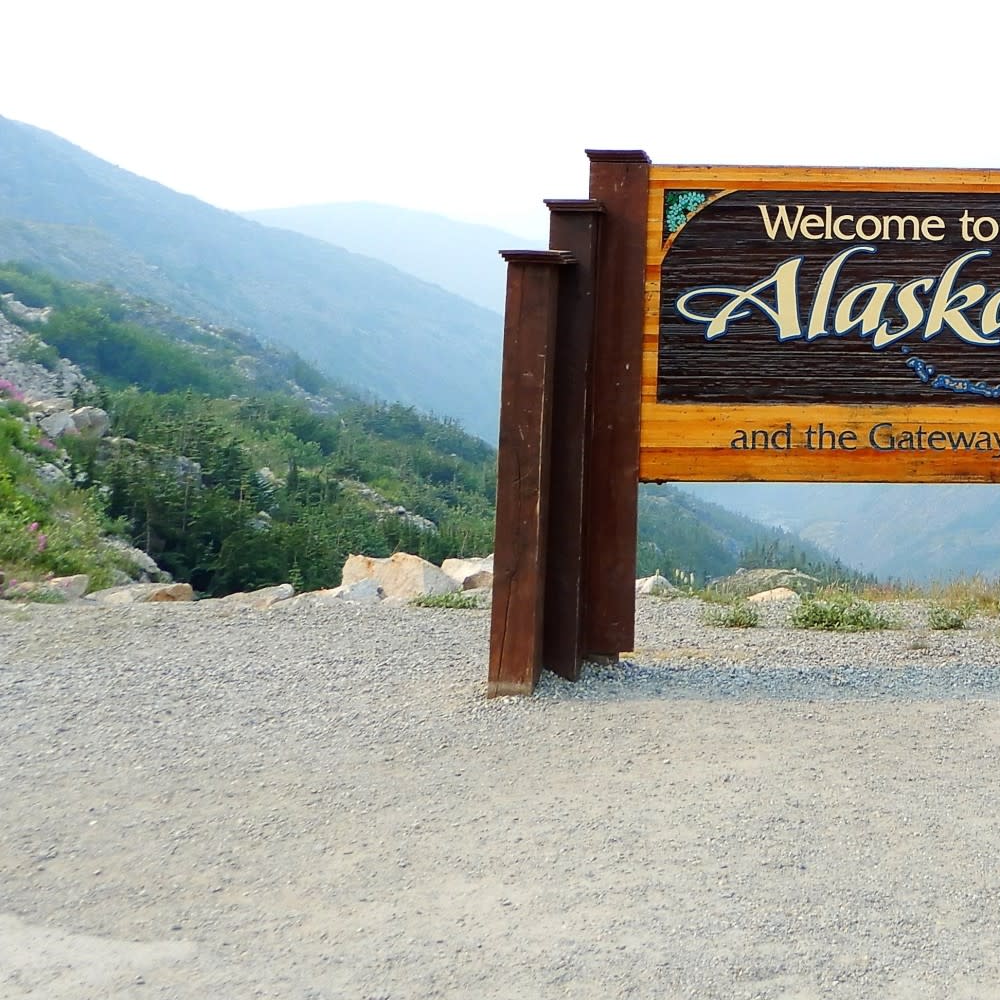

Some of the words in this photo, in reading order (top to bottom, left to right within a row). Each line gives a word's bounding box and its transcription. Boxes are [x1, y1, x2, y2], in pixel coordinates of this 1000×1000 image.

[757, 204, 946, 242] Welcome
[959, 209, 999, 242] to
[730, 423, 792, 451] and
[805, 424, 858, 451] the
